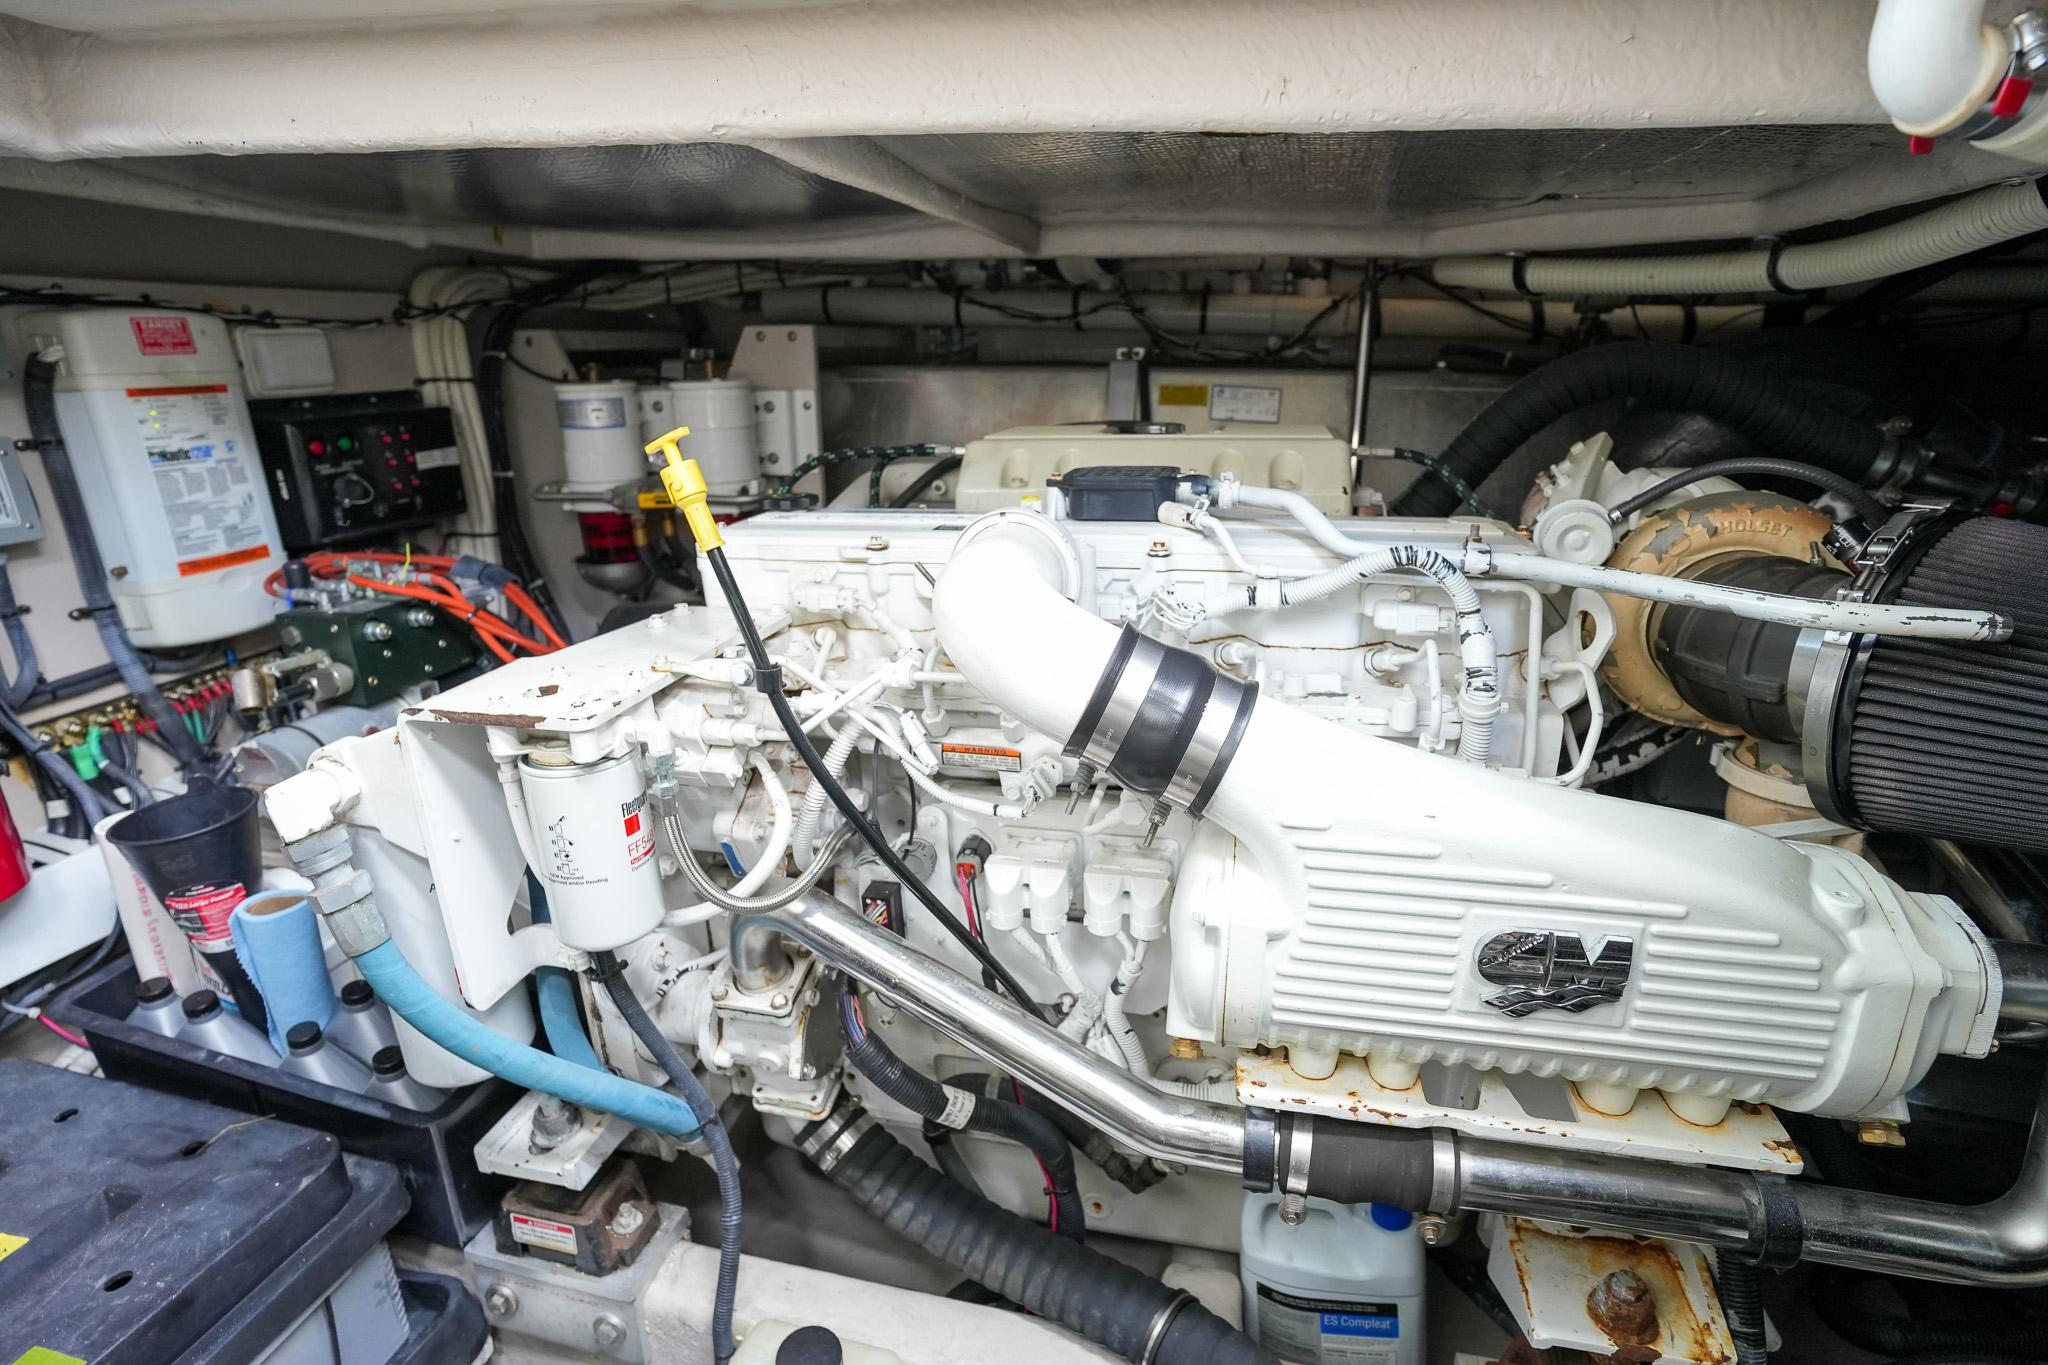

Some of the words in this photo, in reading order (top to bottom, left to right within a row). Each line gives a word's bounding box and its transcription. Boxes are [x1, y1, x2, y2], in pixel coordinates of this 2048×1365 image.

[1719, 518, 1793, 537] HOLSET
[963, 747, 1007, 755] WARNING
[1481, 931, 1544, 967] Cummins
[1324, 1315, 1339, 1326] ES
[1341, 1315, 1392, 1330] Compleat
